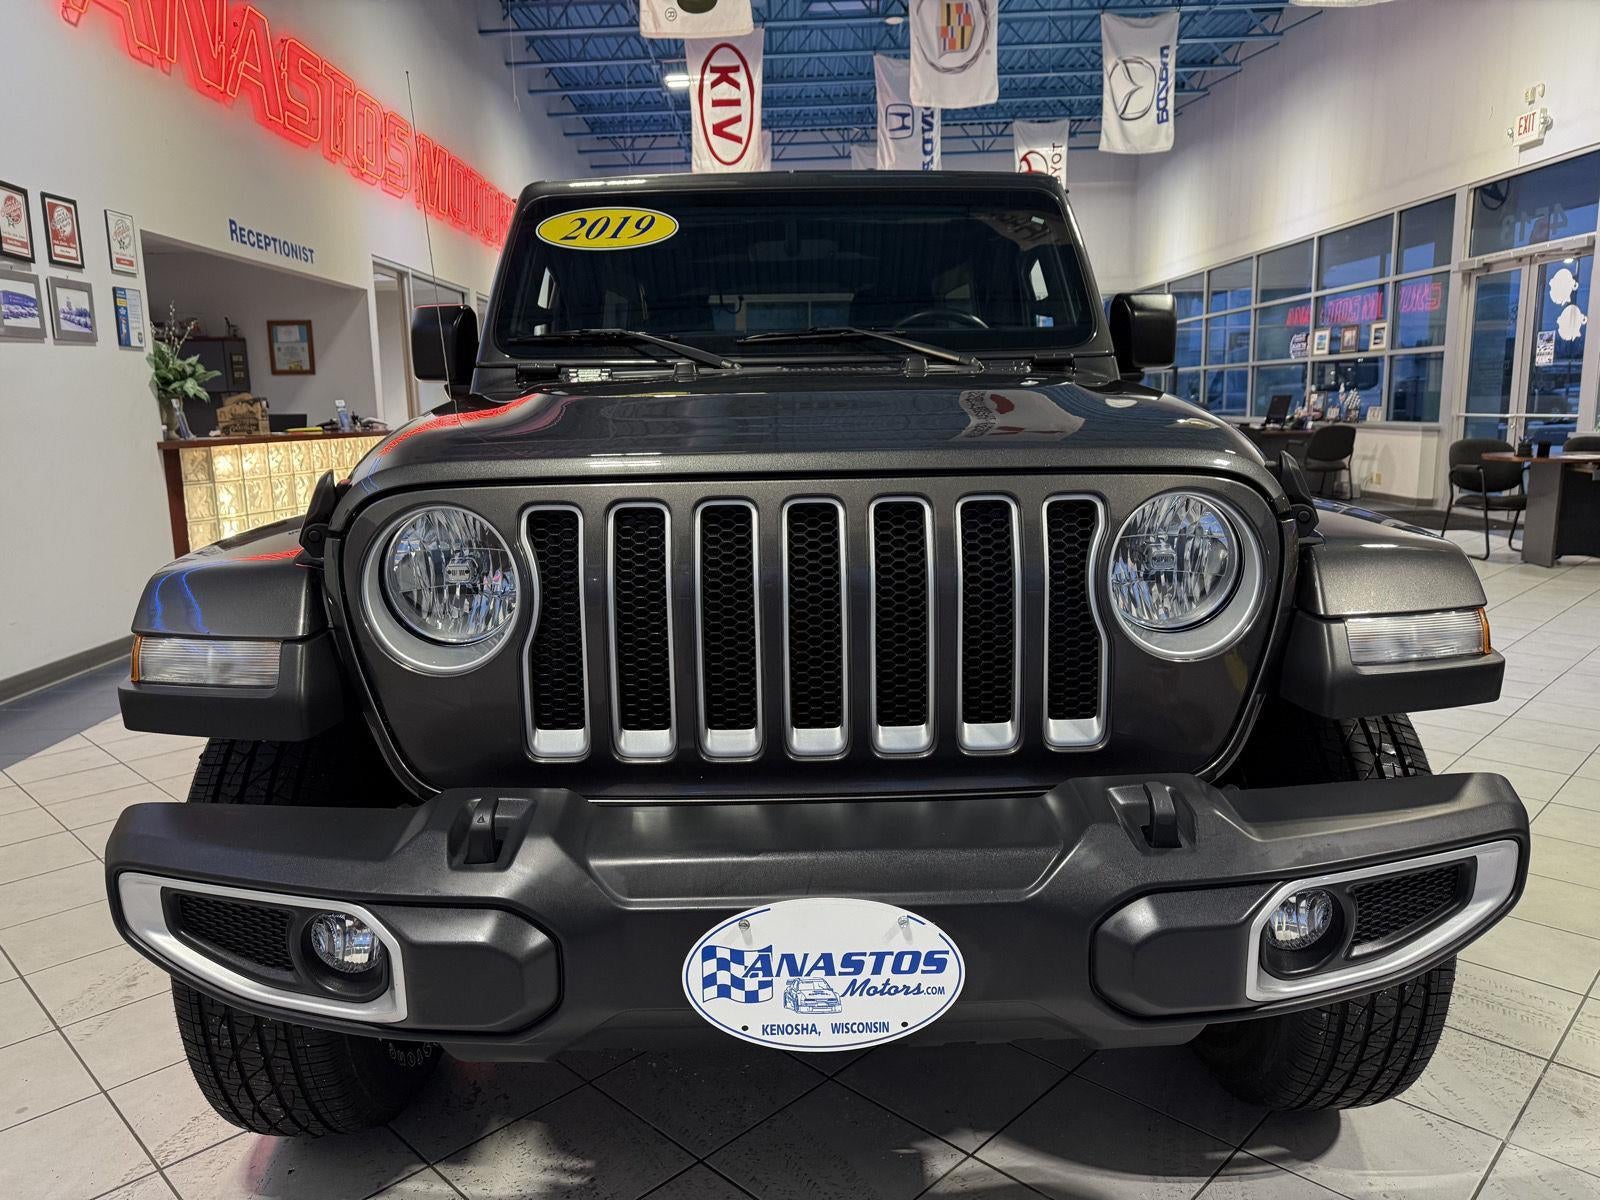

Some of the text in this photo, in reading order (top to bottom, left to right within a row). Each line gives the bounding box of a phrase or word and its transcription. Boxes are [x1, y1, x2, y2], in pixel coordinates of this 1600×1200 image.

[1517, 112, 1537, 137] EXIT
[228, 218, 315, 265] RECEPTIONIST
[560, 214, 656, 242] 2019
[742, 949, 949, 978] ANASTOS
[761, 1021, 890, 1037] KENOSHA, WISCONSIN
